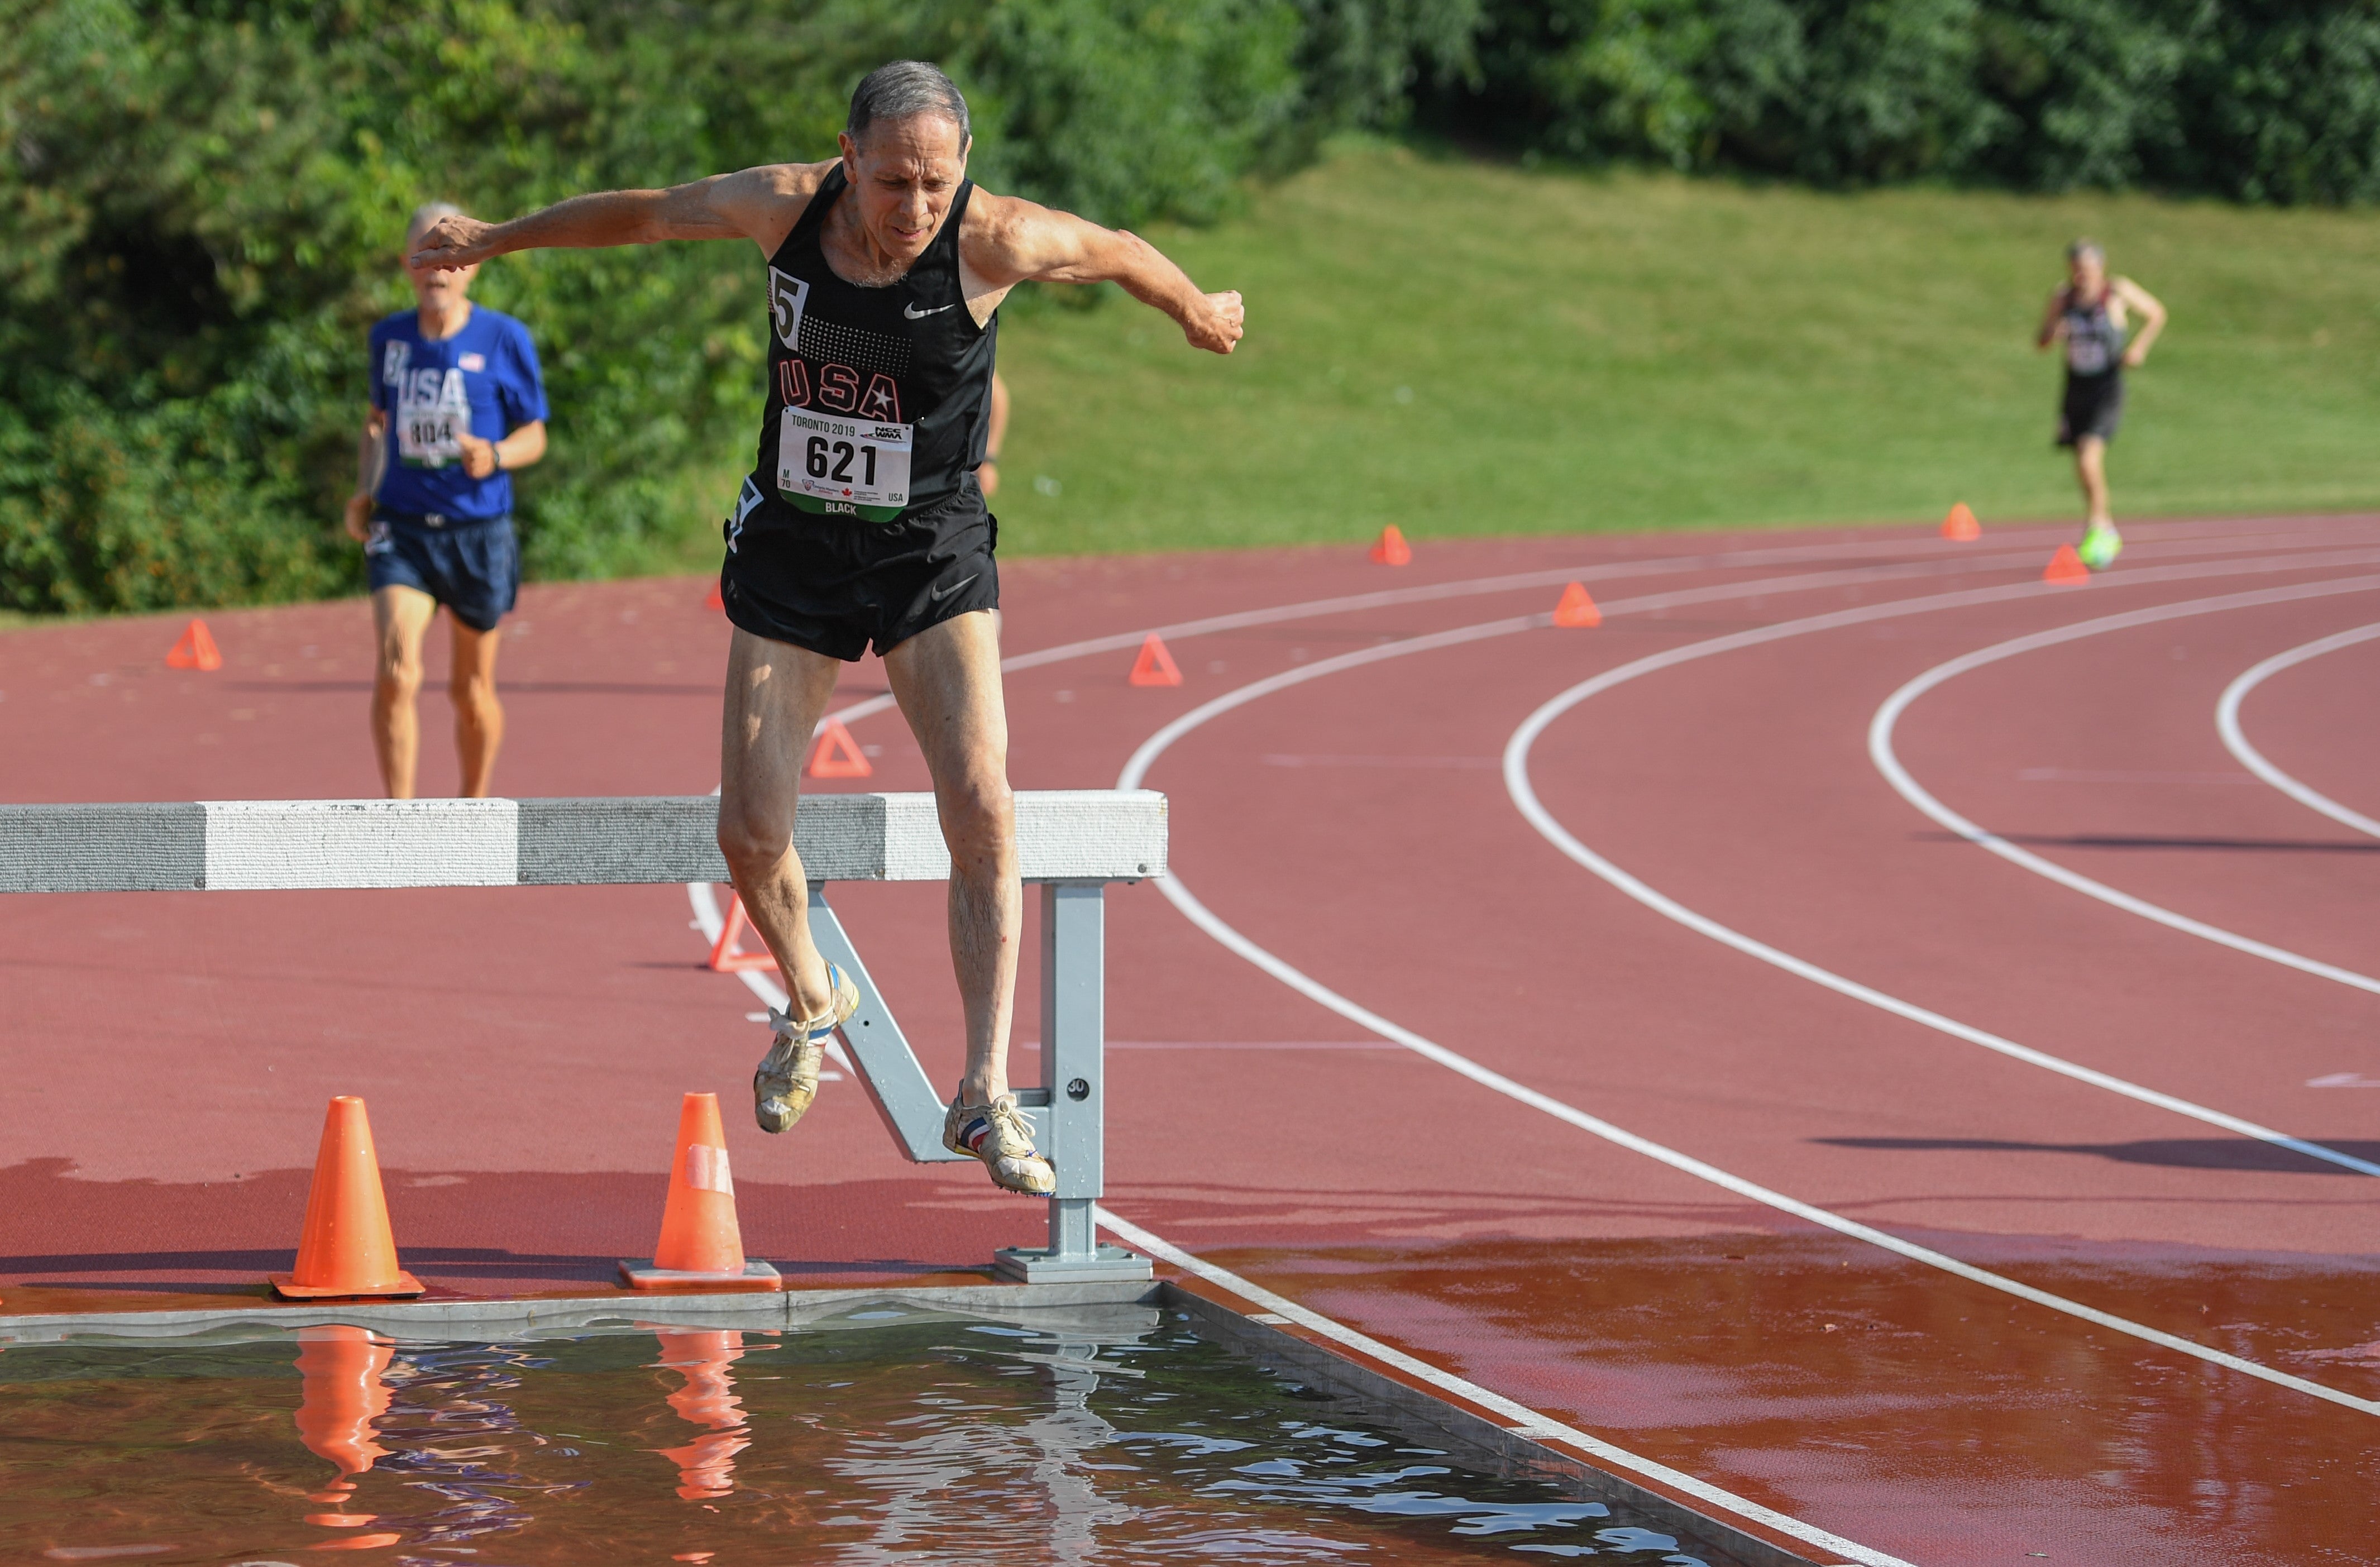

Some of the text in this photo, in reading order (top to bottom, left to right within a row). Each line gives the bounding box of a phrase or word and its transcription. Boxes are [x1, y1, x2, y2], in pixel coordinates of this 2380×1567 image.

[774, 272, 799, 339] 5
[398, 367, 468, 407] USA
[780, 359, 902, 424] USA
[792, 414, 855, 437] TORONTO 2019
[875, 431, 902, 439] WMA
[806, 436, 876, 485] 621
[783, 469, 790, 479] M
[782, 479, 791, 489] 70
[888, 493, 904, 501] USA
[825, 502, 857, 515] BLACK
[1068, 1079, 1084, 1092] 30
